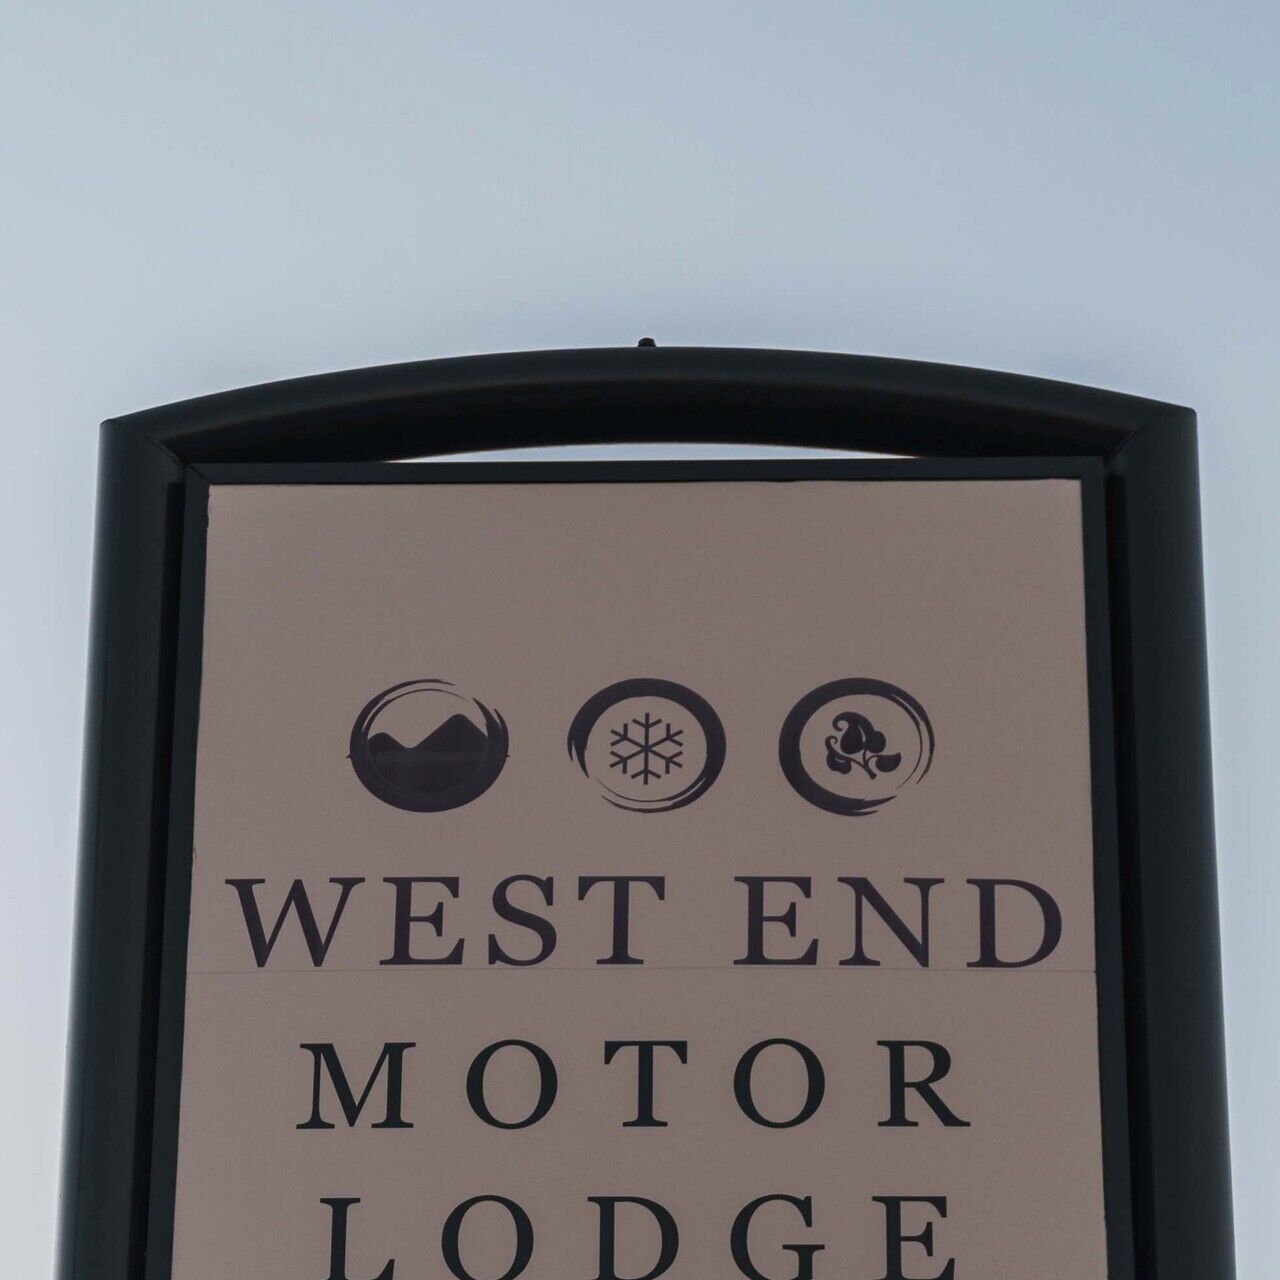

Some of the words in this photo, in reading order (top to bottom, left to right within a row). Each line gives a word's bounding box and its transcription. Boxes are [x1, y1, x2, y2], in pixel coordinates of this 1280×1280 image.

[224, 874, 666, 968] WEST
[733, 875, 1064, 969] END
[295, 1037, 972, 1131] MOTOR
